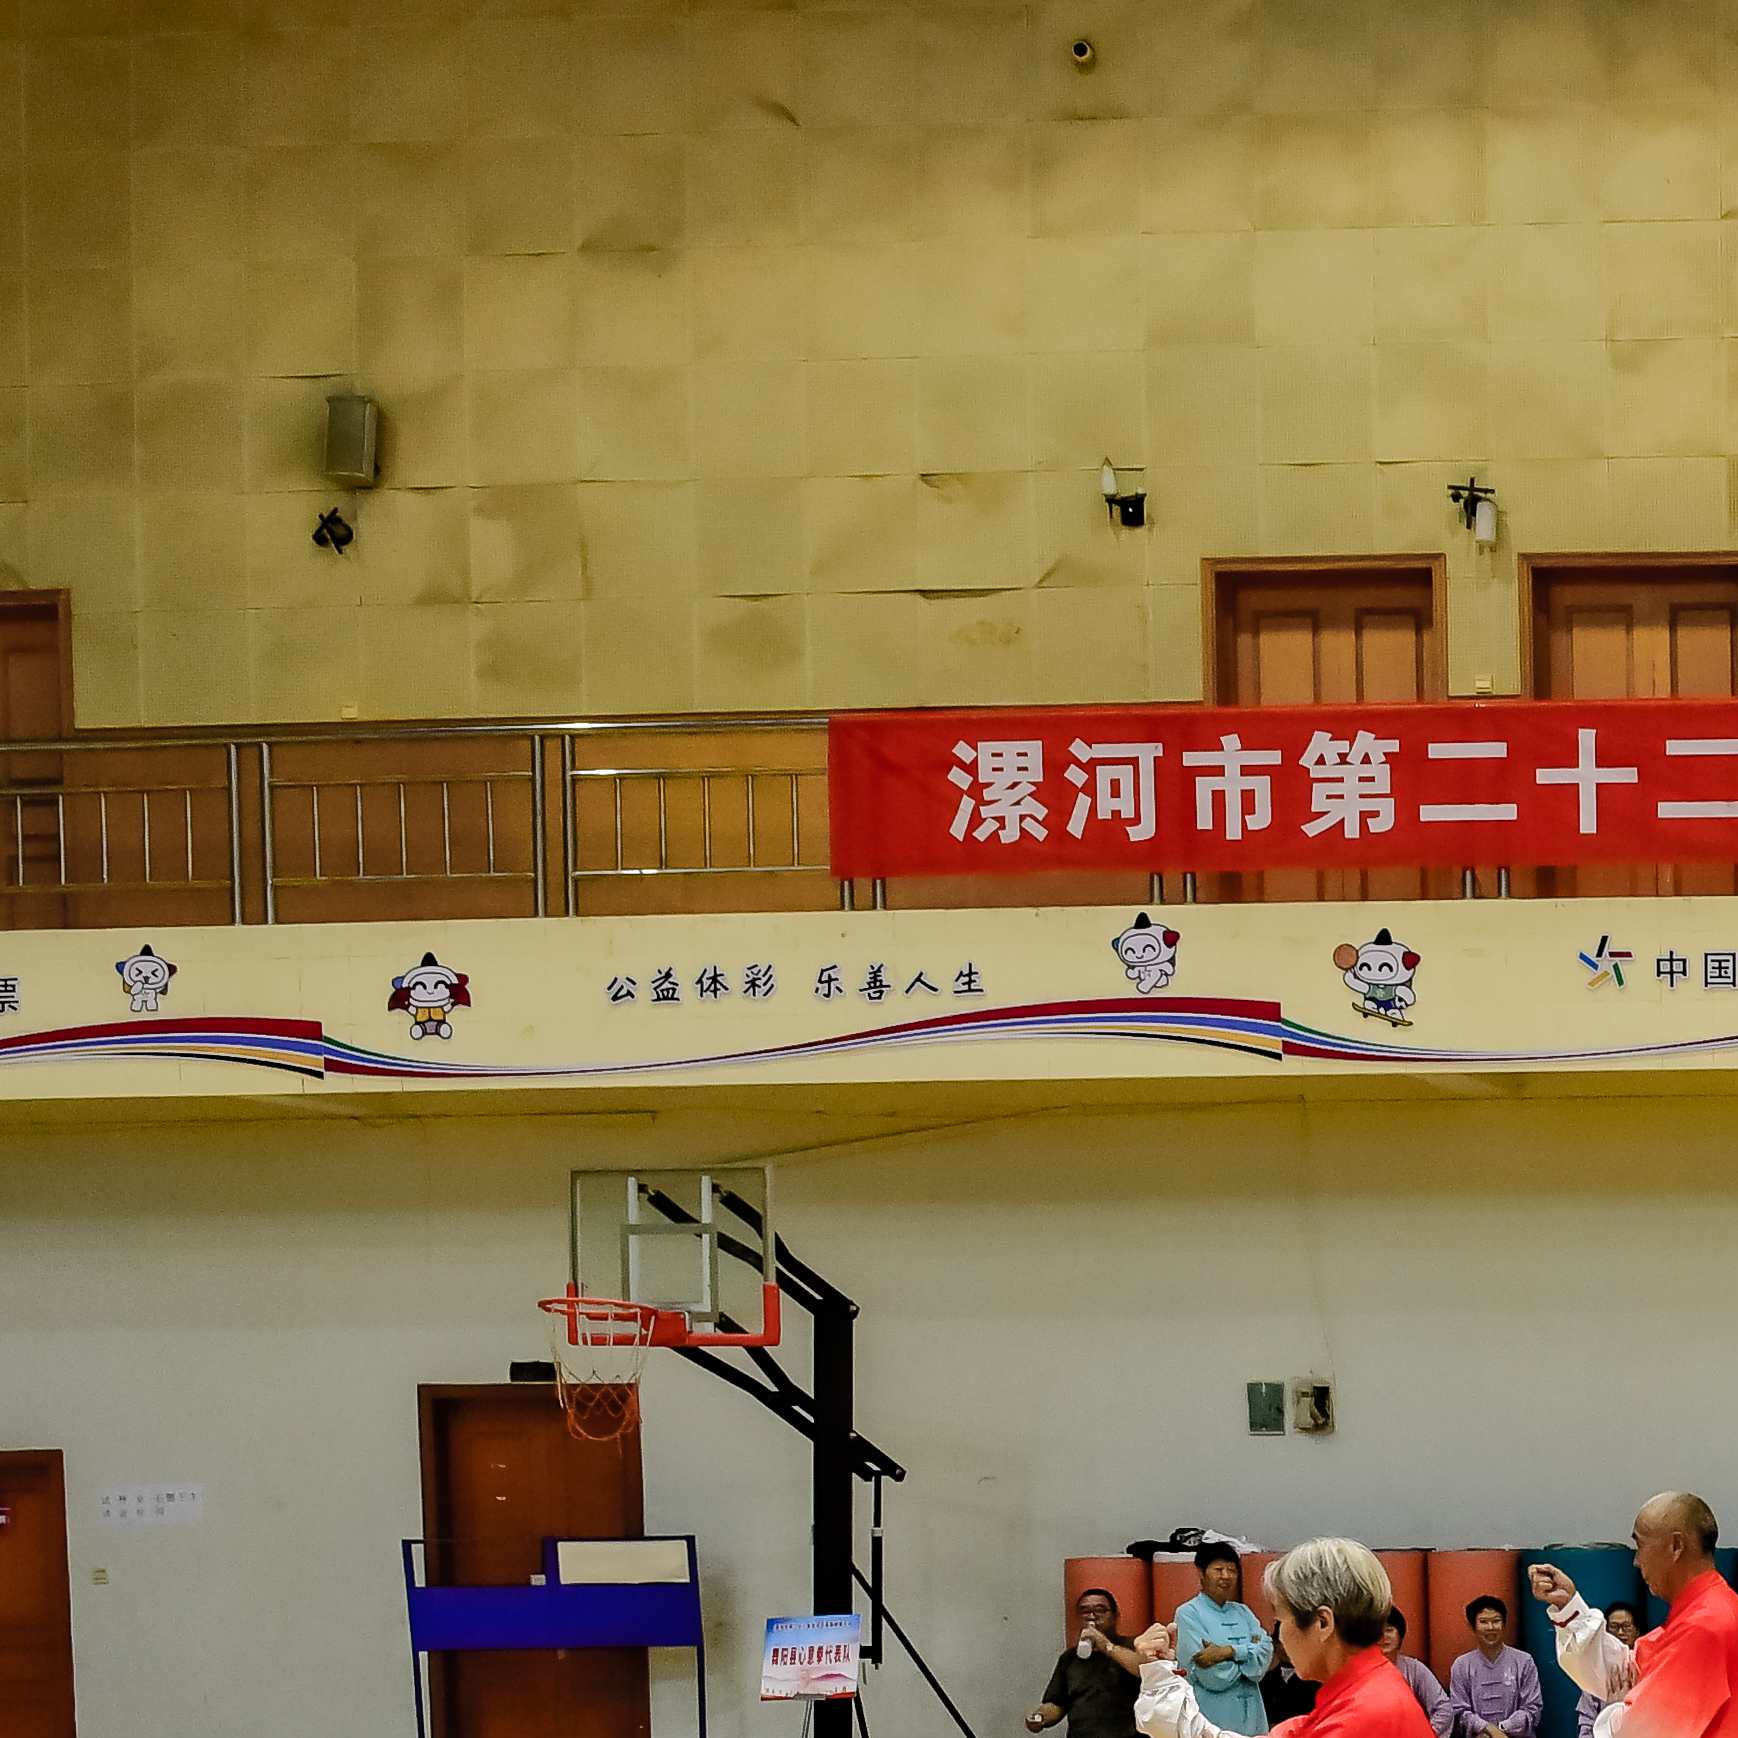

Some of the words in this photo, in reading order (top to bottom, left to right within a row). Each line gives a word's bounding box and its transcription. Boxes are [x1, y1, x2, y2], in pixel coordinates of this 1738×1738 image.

[606, 963, 779, 1002] 公益体彩
[812, 961, 987, 1002] 乐善人生
